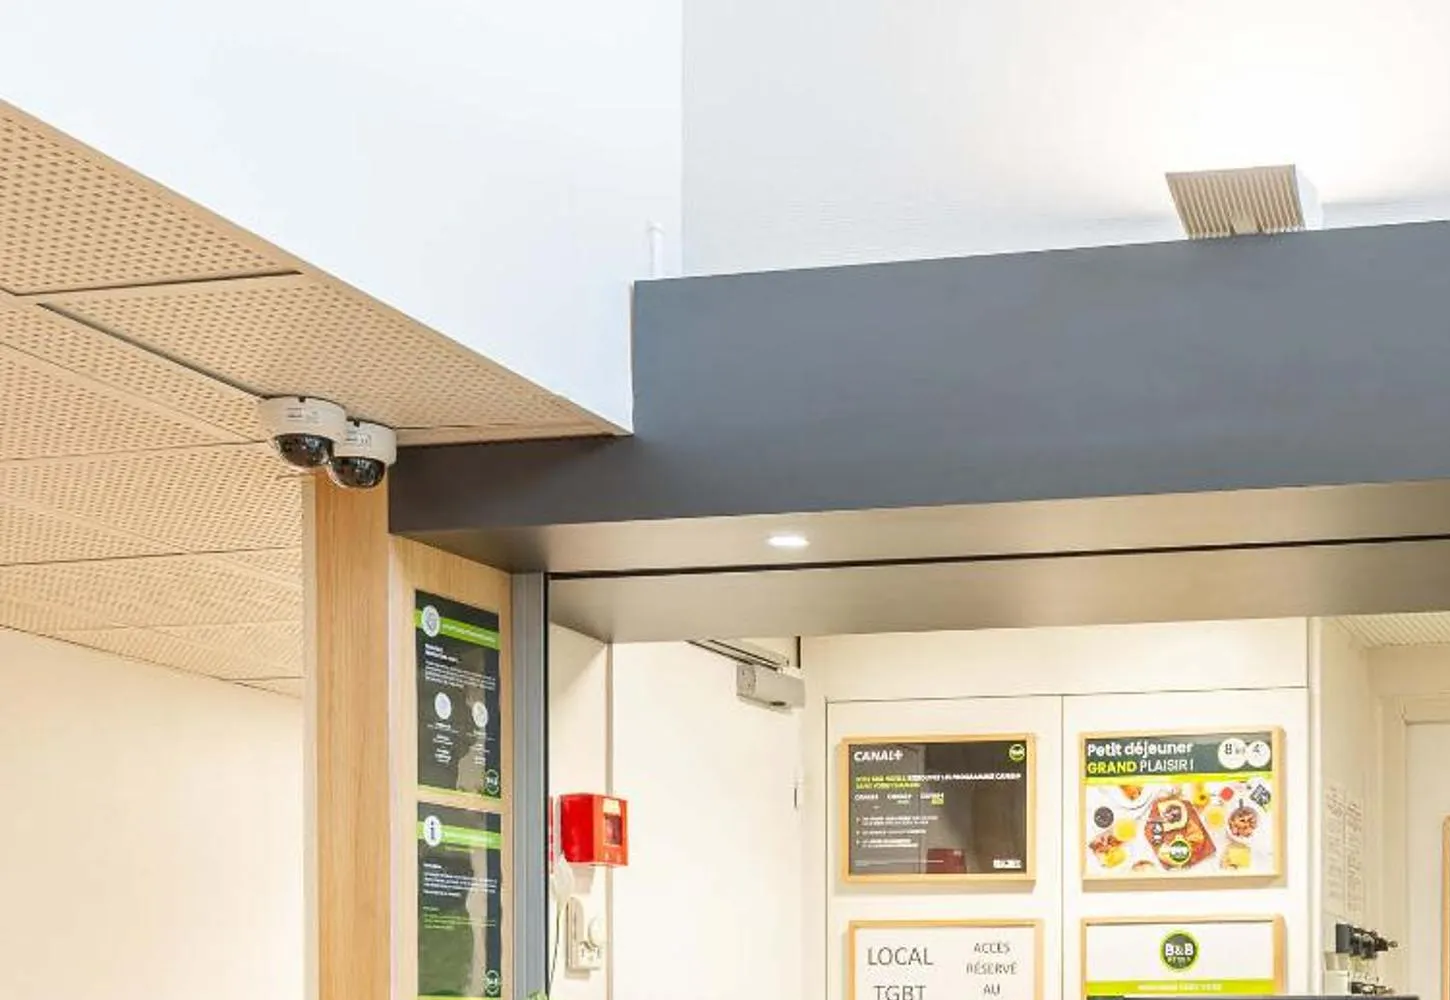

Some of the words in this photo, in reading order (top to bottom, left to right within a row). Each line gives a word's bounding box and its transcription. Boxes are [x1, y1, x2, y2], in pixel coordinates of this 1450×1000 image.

[854, 749, 903, 761] CANAL+
[1087, 741, 1123, 757] Petit
[1124, 741, 1194, 757] déjeuner
[1087, 761, 1137, 774] GRAND
[1139, 759, 1189, 772] PLAISIR
[867, 947, 934, 966] LOCAL
[1165, 943, 1194, 956] B&B
[983, 983, 1001, 995] AU
